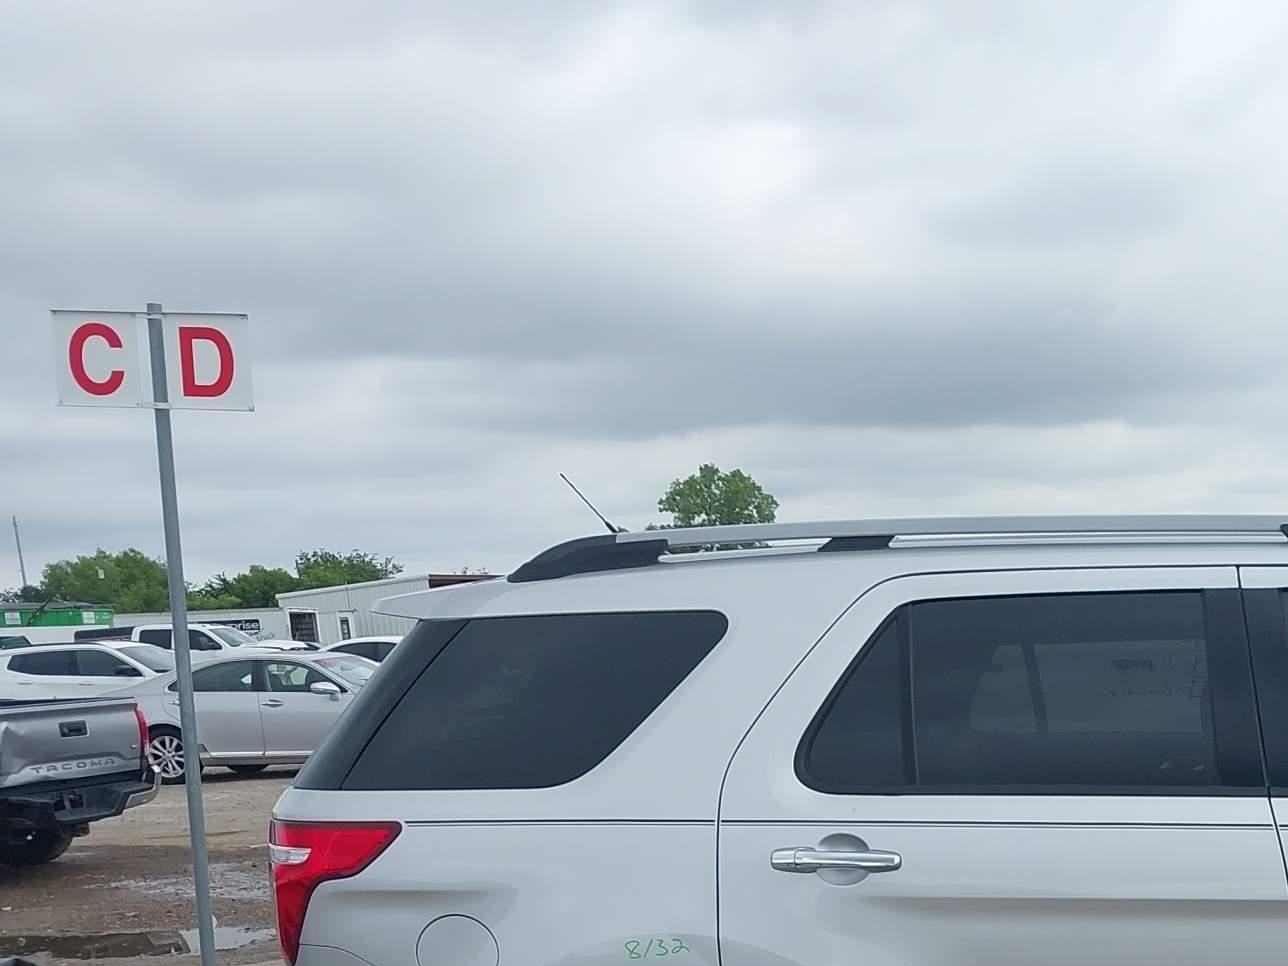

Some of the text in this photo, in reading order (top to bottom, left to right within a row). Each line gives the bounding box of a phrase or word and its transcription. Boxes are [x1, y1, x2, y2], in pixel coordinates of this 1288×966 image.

[69, 322, 125, 396] C
[178, 326, 235, 398] D
[30, 758, 116, 775] TACOMA
[624, 938, 690, 960] 8/32
